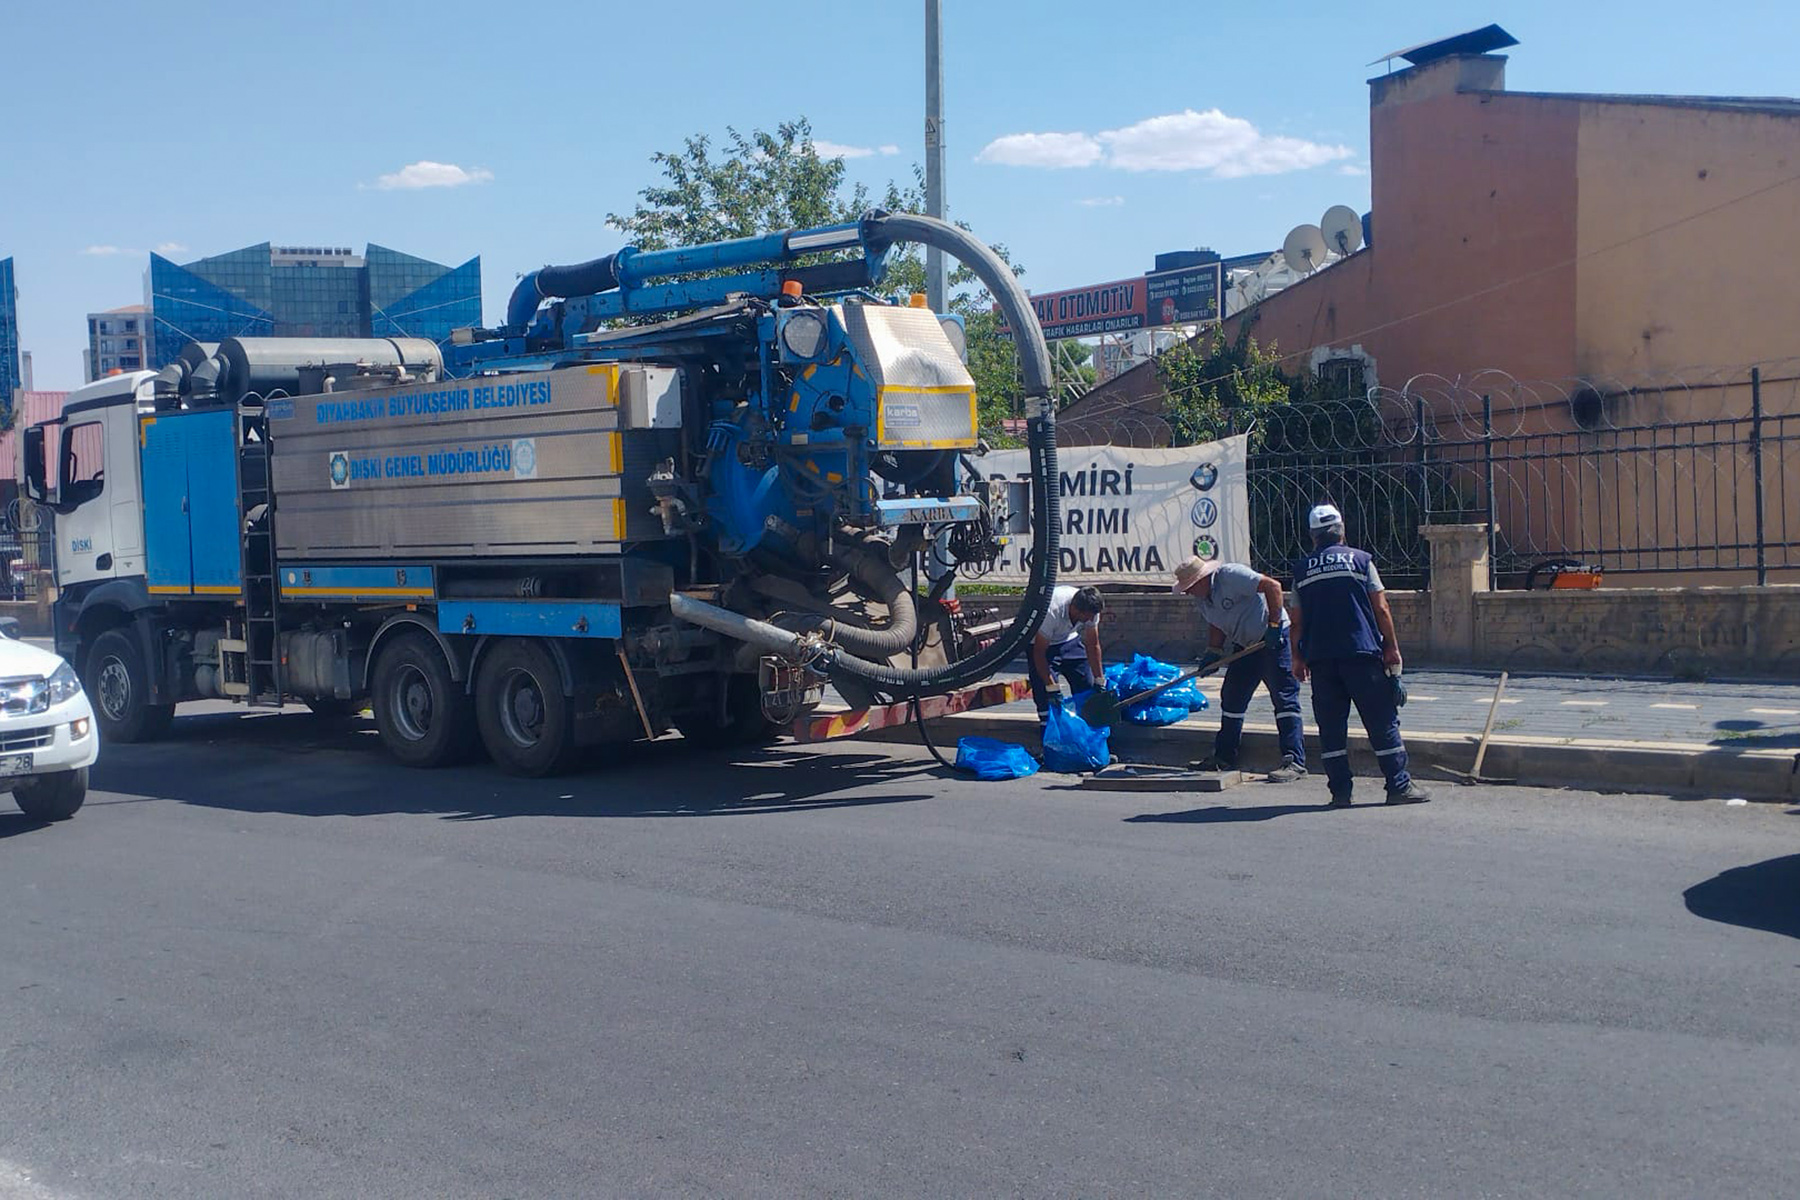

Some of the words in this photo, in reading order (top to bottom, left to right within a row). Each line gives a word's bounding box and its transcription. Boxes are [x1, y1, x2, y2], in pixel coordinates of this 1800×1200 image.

[1059, 283, 1135, 320] OTOMOTİV
[473, 375, 551, 409] BELEDİYESİ
[385, 455, 425, 478] GENEL
[427, 444, 511, 475] MÜDÜRLÜĞÜ
[909, 505, 955, 521] KARBA
[1020, 544, 1166, 573] KDLAMA
[1308, 551, 1355, 569] DİSKİ
